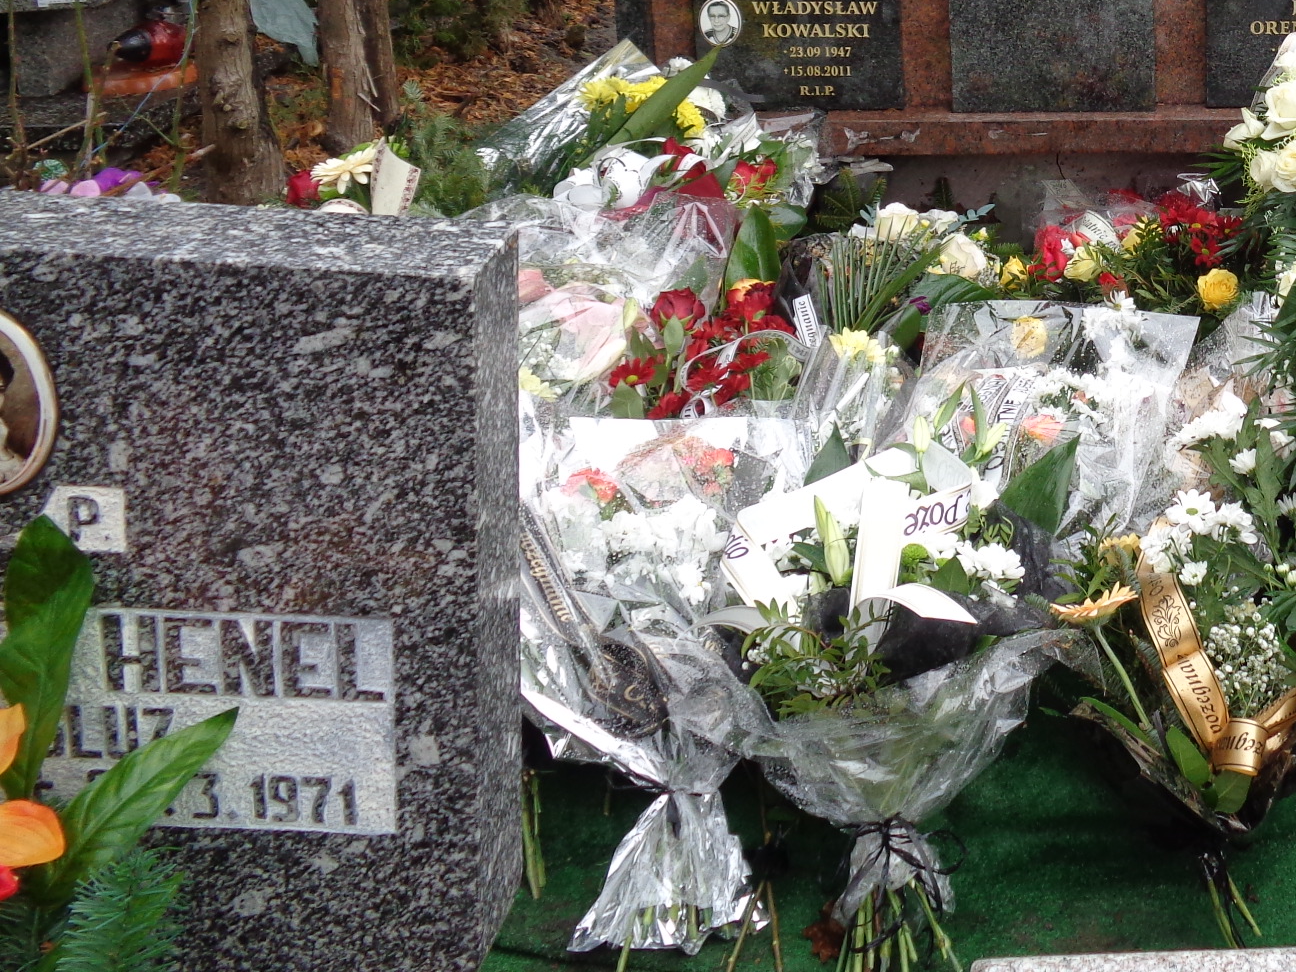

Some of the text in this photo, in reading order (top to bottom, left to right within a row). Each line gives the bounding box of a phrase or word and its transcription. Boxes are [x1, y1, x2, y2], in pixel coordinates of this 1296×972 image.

[751, 0, 878, 16] WŁADYSŁAW
[762, 23, 870, 38] KOWALSKI
[101, 614, 388, 702] HENEL
